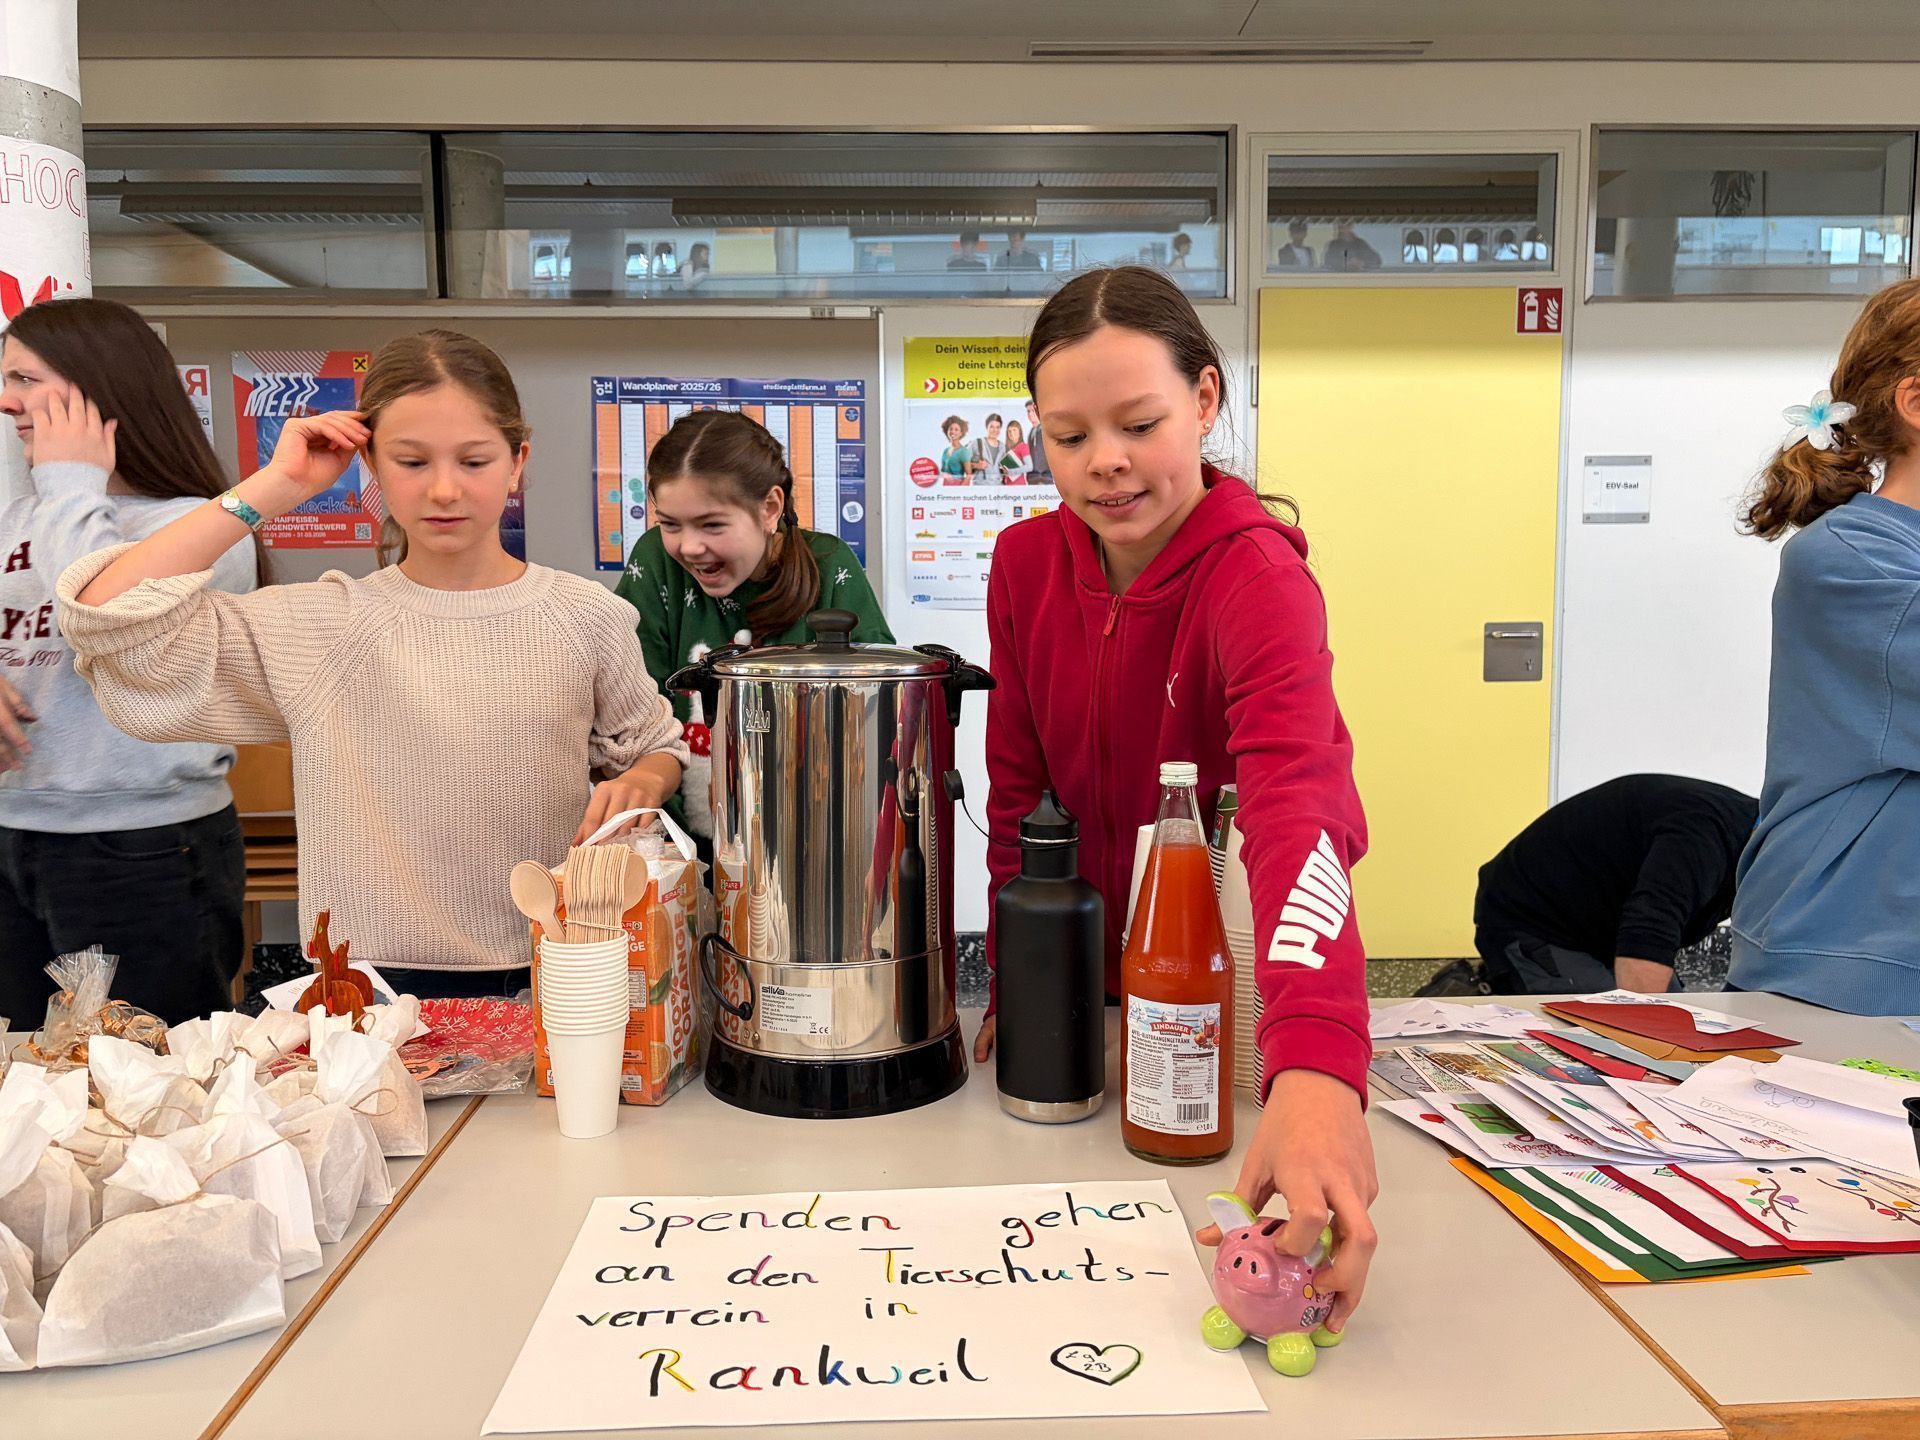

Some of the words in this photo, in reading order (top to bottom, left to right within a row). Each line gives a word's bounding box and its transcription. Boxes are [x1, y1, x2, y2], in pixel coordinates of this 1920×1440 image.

[0, 152, 87, 218] HOC
[945, 344, 969, 354] Dein
[958, 360, 986, 369] deine
[988, 360, 1026, 369] Lehrste
[622, 381, 679, 393] Wandplaner
[680, 383, 722, 392] 2025/26
[941, 377, 1028, 393] jobeinsteige
[1606, 481, 1639, 490] EDV-Saal
[915, 493, 938, 502] Diese
[940, 493, 962, 502] Firmen
[963, 493, 987, 502] suchen
[988, 493, 1021, 504] Lehrlinge
[1023, 493, 1037, 502] und
[262, 523, 347, 531] JUGENDWETTBEWERB
[1266, 828, 1351, 970] PUMA
[673, 911, 692, 1036] ORANGE
[762, 985, 785, 996] silva
[671, 975, 683, 1060] 100%
[1153, 1023, 1189, 1033] LINDAUER
[619, 1192, 902, 1248] Spenden
[1001, 1195, 1173, 1248] gehen
[594, 1262, 674, 1285] an
[726, 1254, 820, 1288] den
[863, 1297, 919, 1319] in
[637, 1337, 990, 1398] Rankweil
